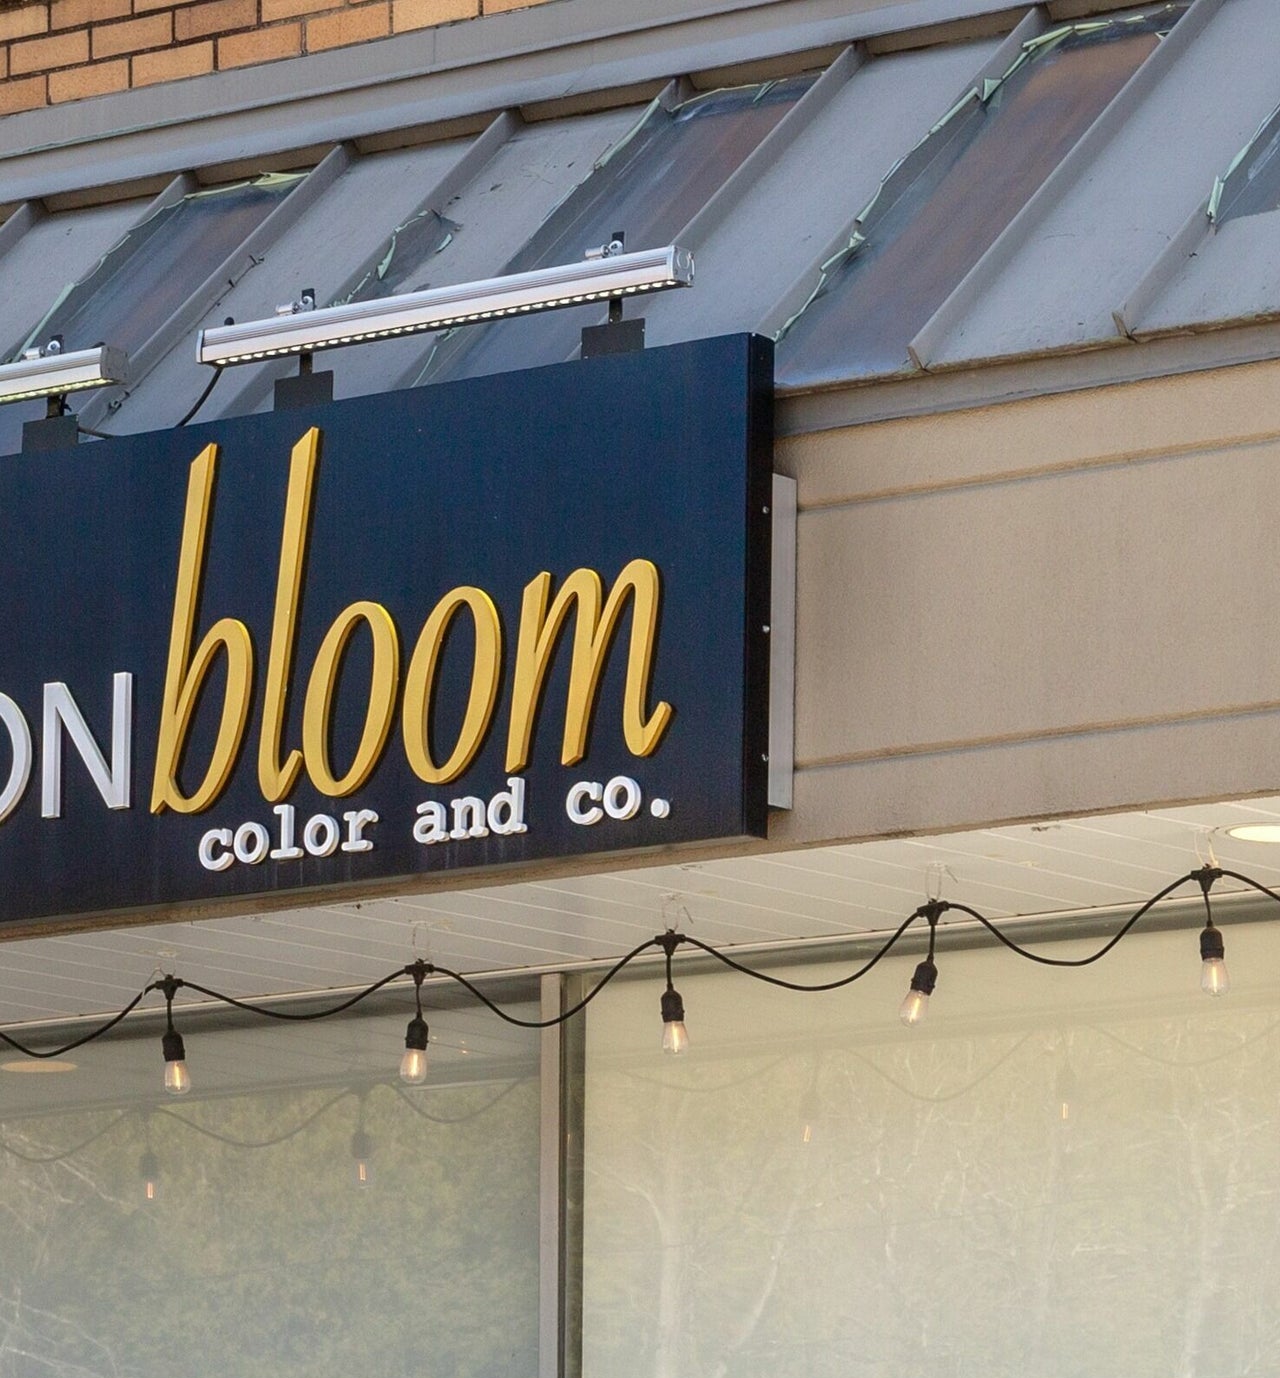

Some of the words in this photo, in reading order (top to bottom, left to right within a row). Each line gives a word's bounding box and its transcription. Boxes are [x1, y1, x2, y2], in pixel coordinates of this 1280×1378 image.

[151, 426, 674, 815] bloom
[198, 804, 380, 872] color
[413, 777, 528, 845] and
[566, 774, 671, 826] co.
